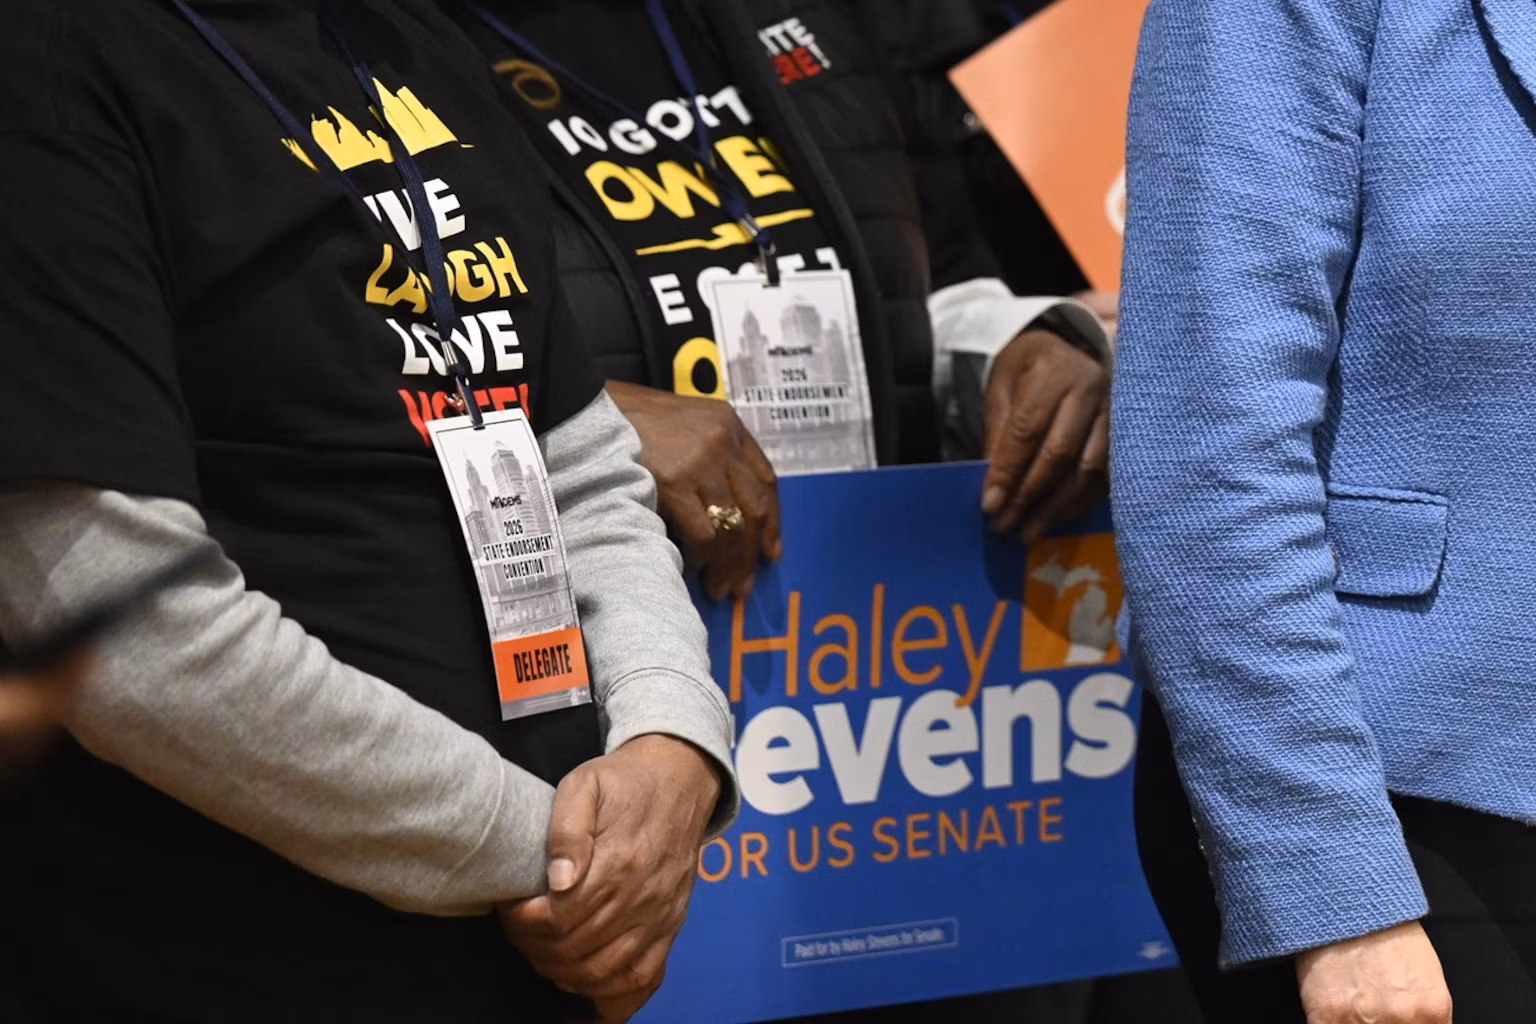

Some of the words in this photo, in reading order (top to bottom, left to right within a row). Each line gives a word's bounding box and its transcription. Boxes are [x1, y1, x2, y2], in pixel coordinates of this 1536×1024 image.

[584, 136, 796, 221] OWE
[385, 309, 524, 376] LOVE
[398, 383, 531, 448] VE!
[482, 542, 506, 562] STATE
[504, 534, 554, 559] ENDORSEMENT
[503, 518, 524, 537] 2026
[503, 557, 545, 580] CONVENTION
[512, 643, 573, 684] DELEGATE
[730, 583, 1008, 708] Haley
[731, 673, 1140, 815] evens
[696, 832, 769, 882] OR
[788, 822, 855, 873] US
[872, 798, 1064, 863] SENATE
